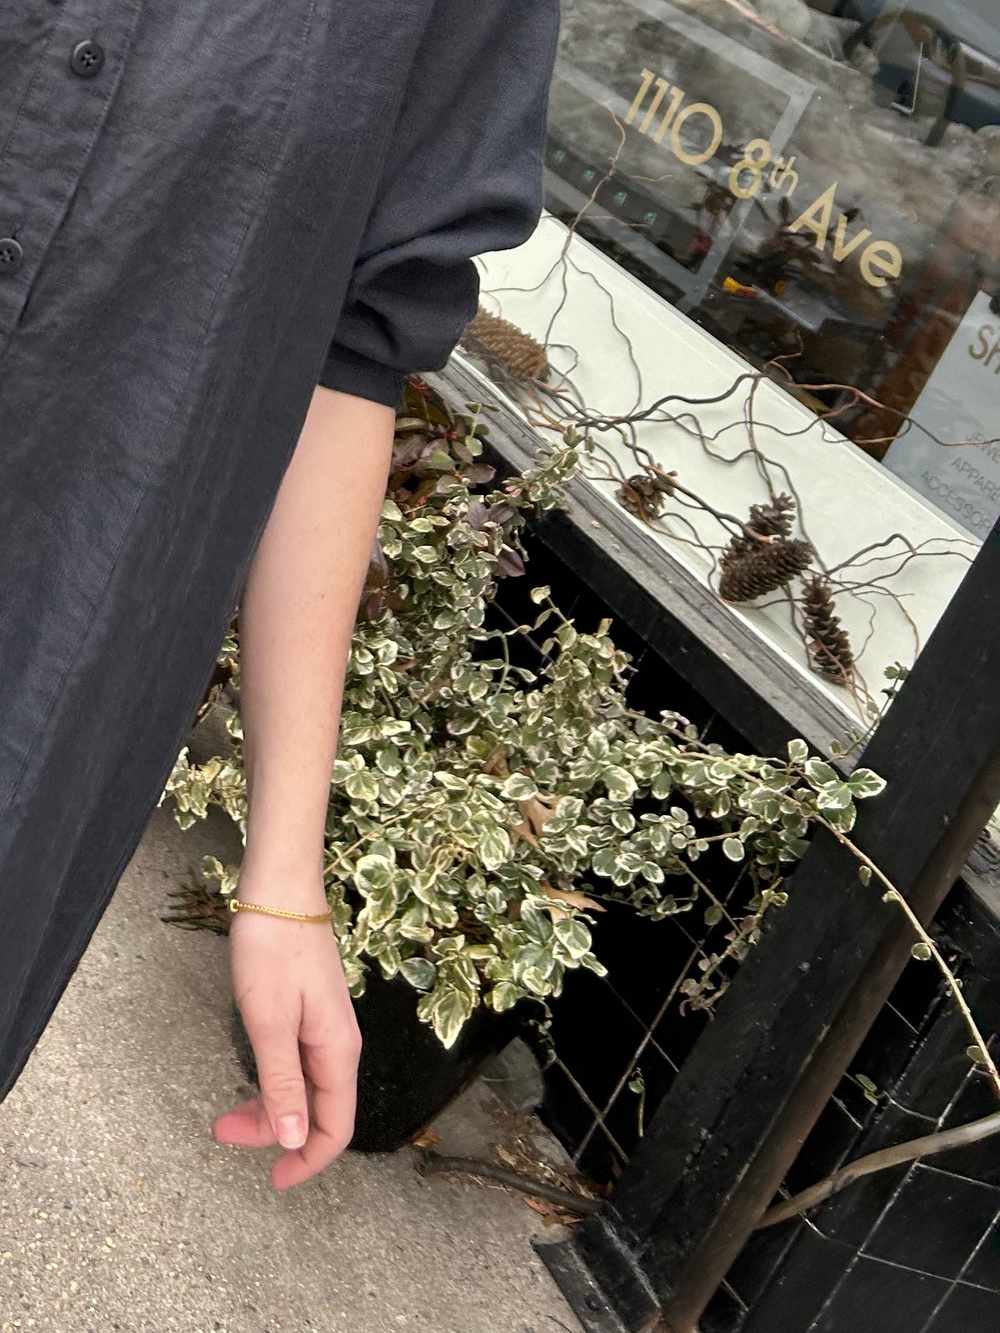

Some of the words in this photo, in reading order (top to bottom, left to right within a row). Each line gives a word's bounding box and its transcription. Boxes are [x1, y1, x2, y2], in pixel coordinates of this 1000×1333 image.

[624, 68, 723, 165] 1110
[728, 137, 799, 200] 8th
[788, 182, 903, 289] Ave
